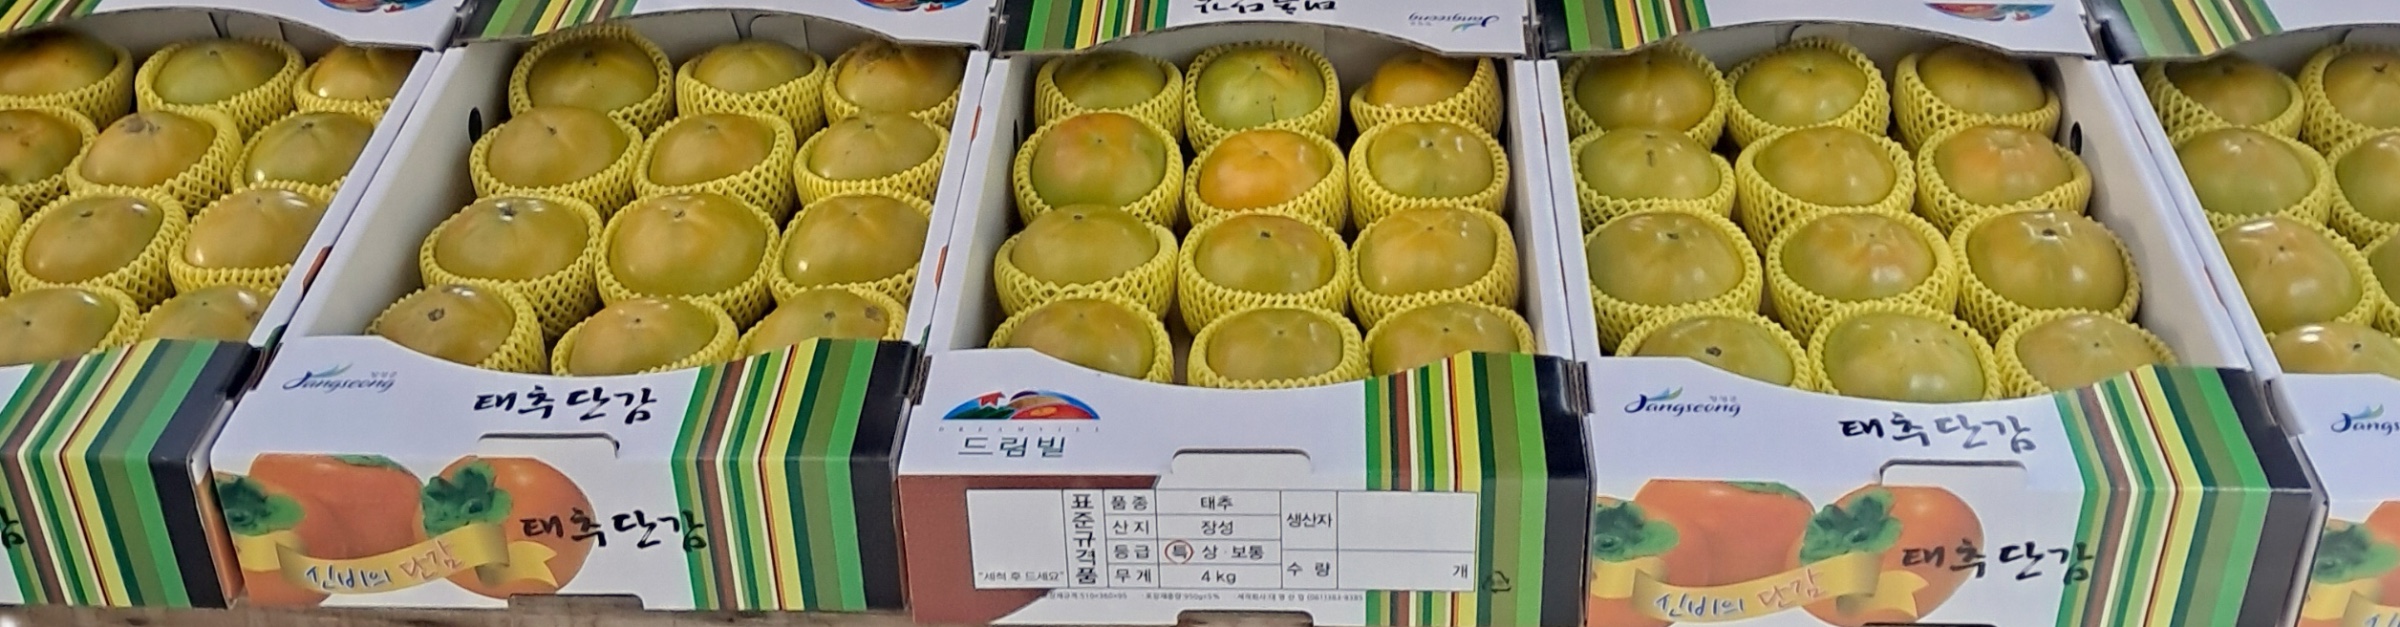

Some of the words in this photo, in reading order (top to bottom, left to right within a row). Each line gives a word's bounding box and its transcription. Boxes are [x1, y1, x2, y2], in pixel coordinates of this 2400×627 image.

[282, 370, 397, 394] Jangseong
[1624, 394, 1741, 417] Jangseong
[958, 436, 1065, 458] 드림빌
[1201, 496, 1234, 511] 태추
[1201, 520, 1234, 536] 장성
[1286, 512, 1332, 528] 생산자
[1172, 544, 1188, 560] 특
[306, 564, 393, 589] 신비의
[1453, 564, 1468, 579] 개
[1655, 593, 1744, 617] 신비의
